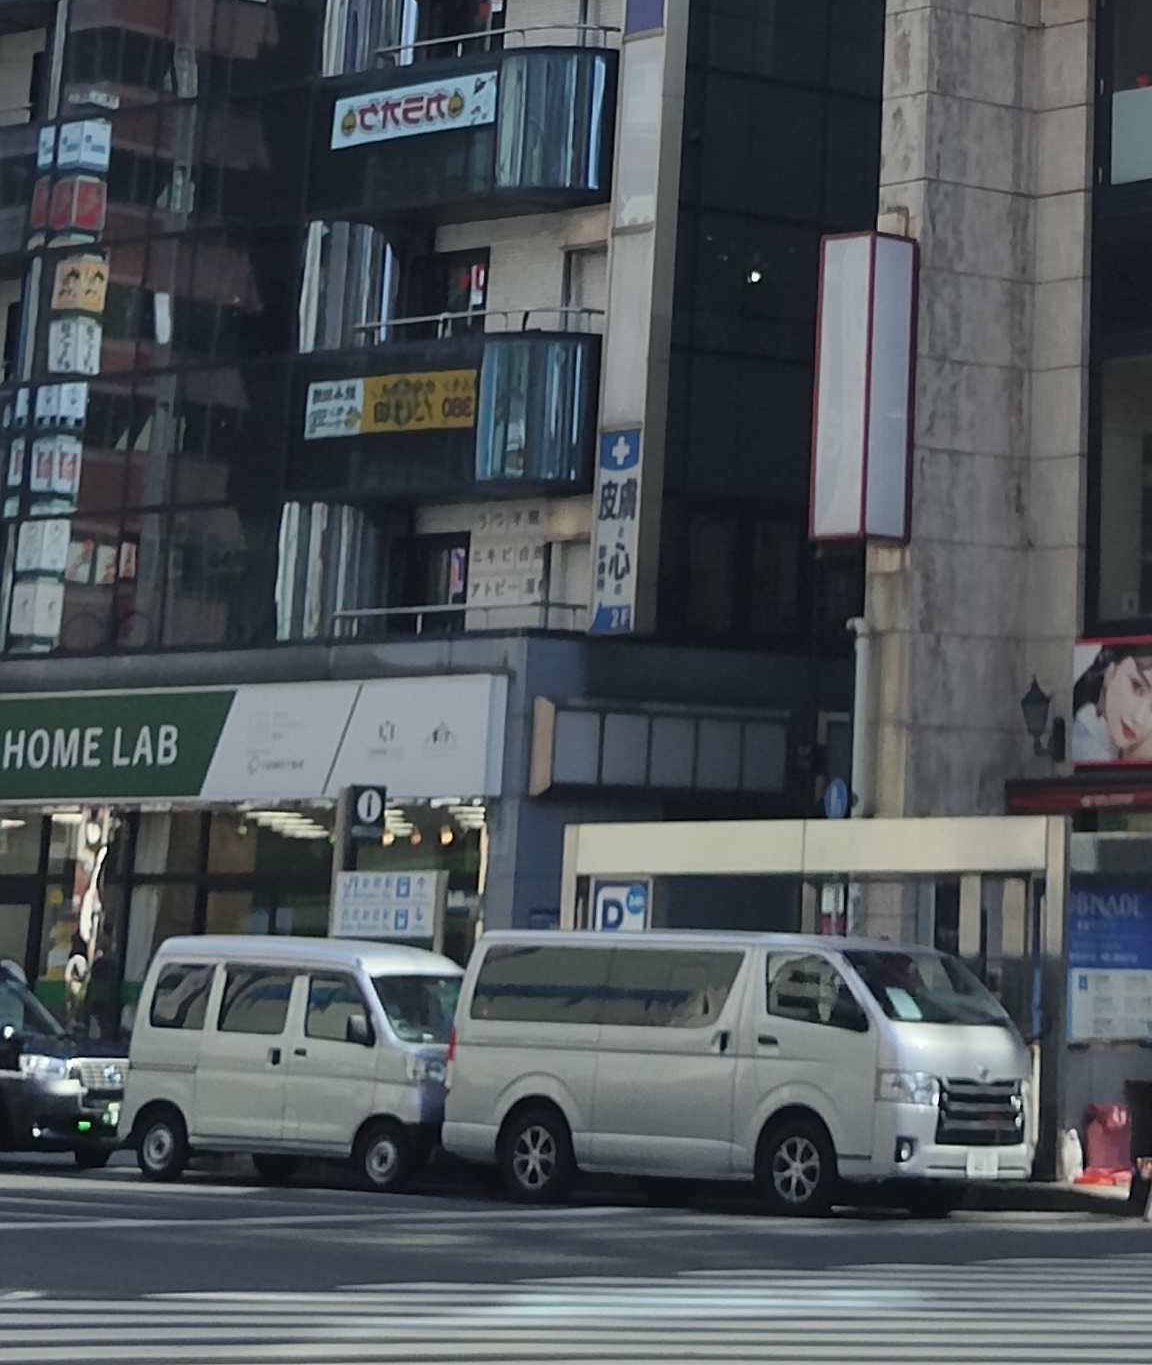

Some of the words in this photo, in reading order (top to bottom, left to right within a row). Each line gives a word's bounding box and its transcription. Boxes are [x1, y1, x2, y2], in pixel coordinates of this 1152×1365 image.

[597, 477, 638, 521] 皮膚
[3, 728, 102, 769] HOME
[112, 724, 179, 767] LAB
